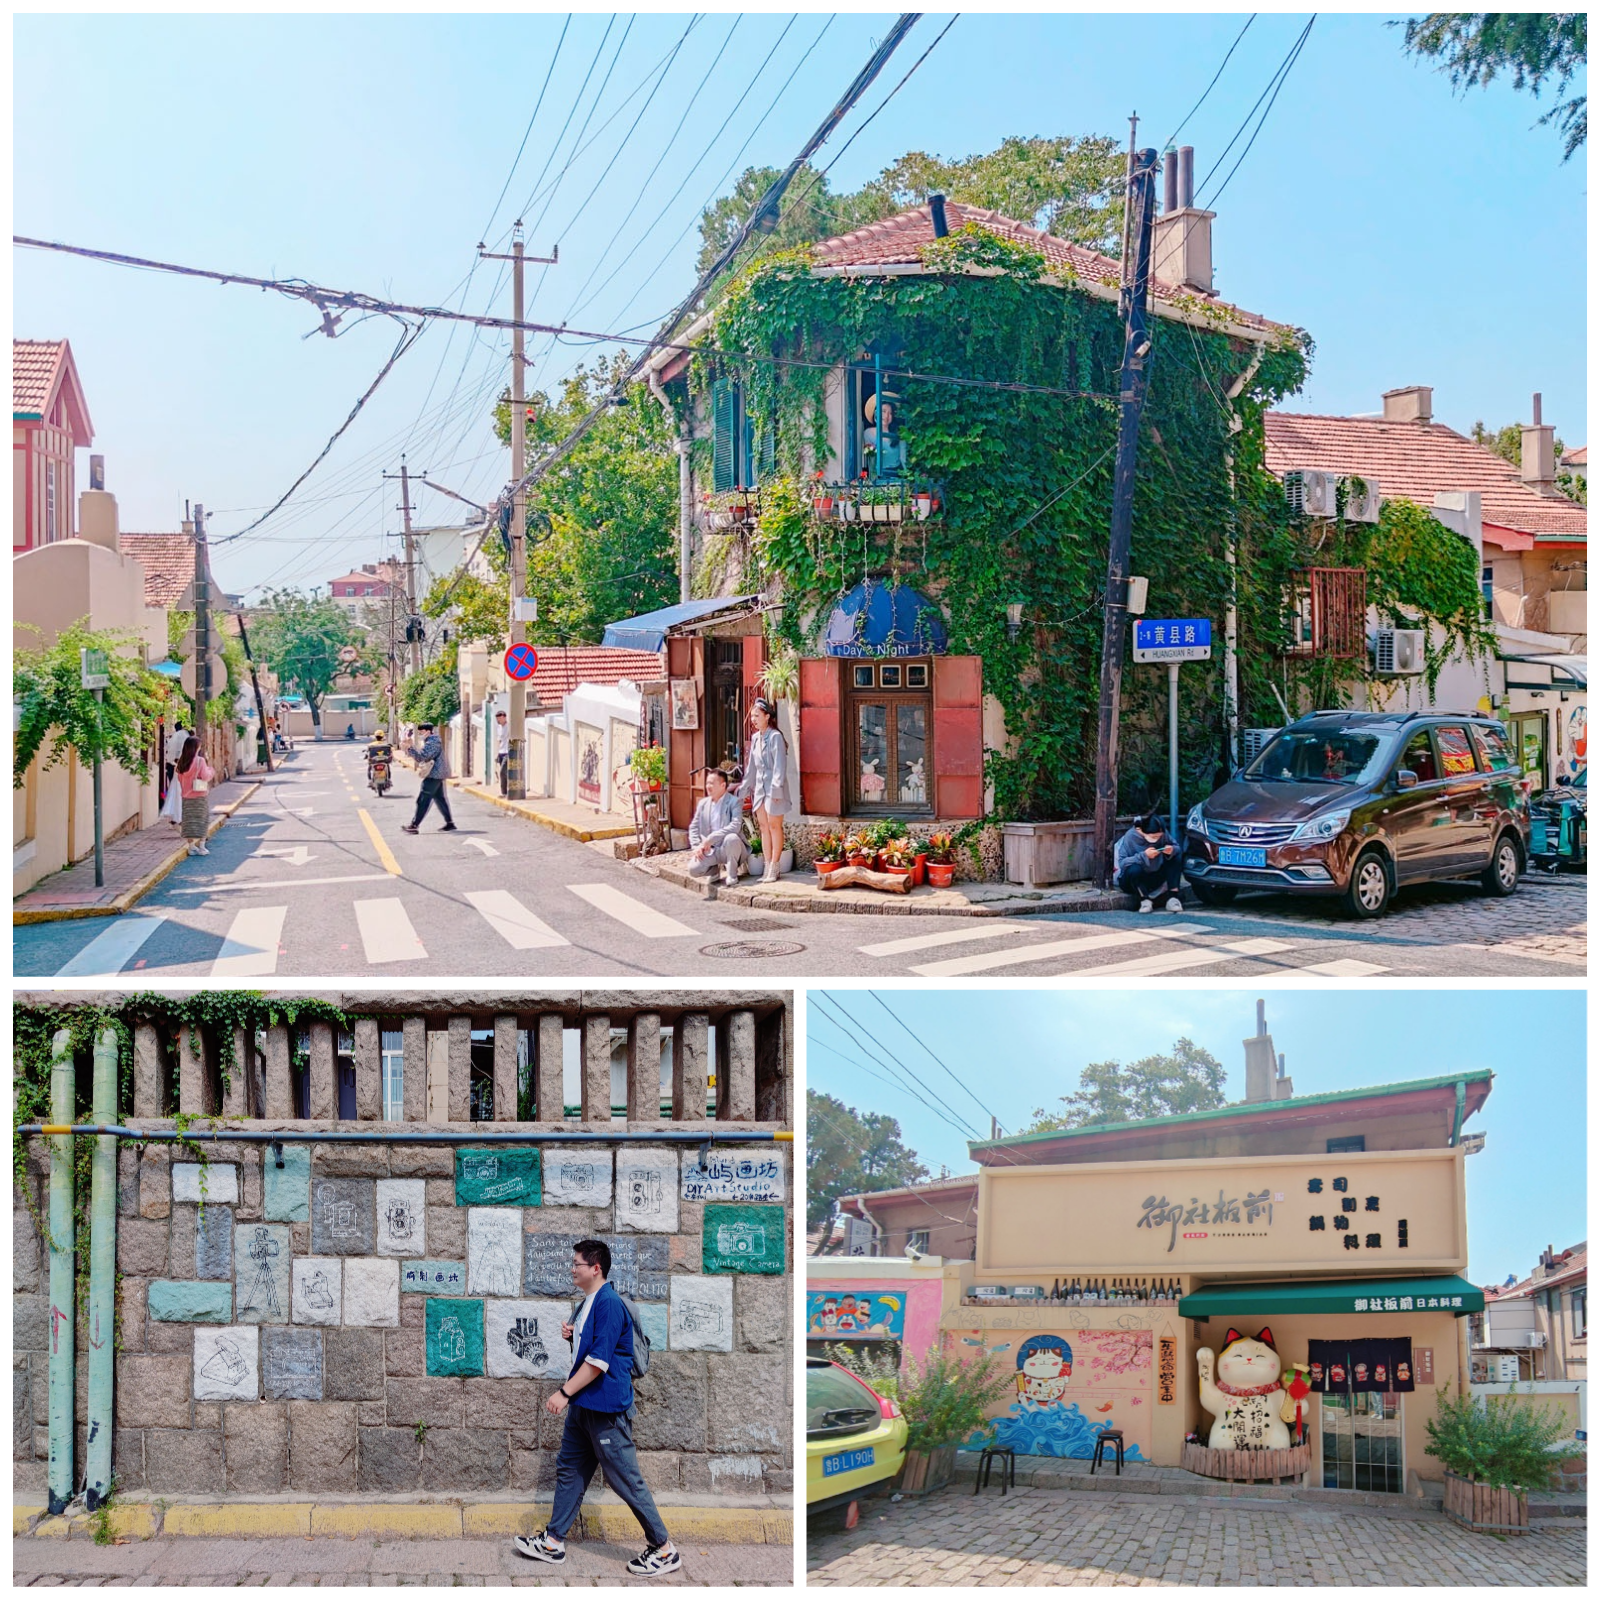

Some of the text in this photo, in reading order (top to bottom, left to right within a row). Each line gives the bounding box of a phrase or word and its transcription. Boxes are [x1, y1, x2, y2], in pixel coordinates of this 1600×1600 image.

[1154, 625, 1196, 645] 黄县路
[843, 644, 863, 658] Day
[877, 643, 910, 658] Night
[687, 1183, 704, 1195] DIY
[713, 1257, 780, 1269] Vintage Camera
[1354, 1296, 1463, 1312] 御社板前 日本料理
